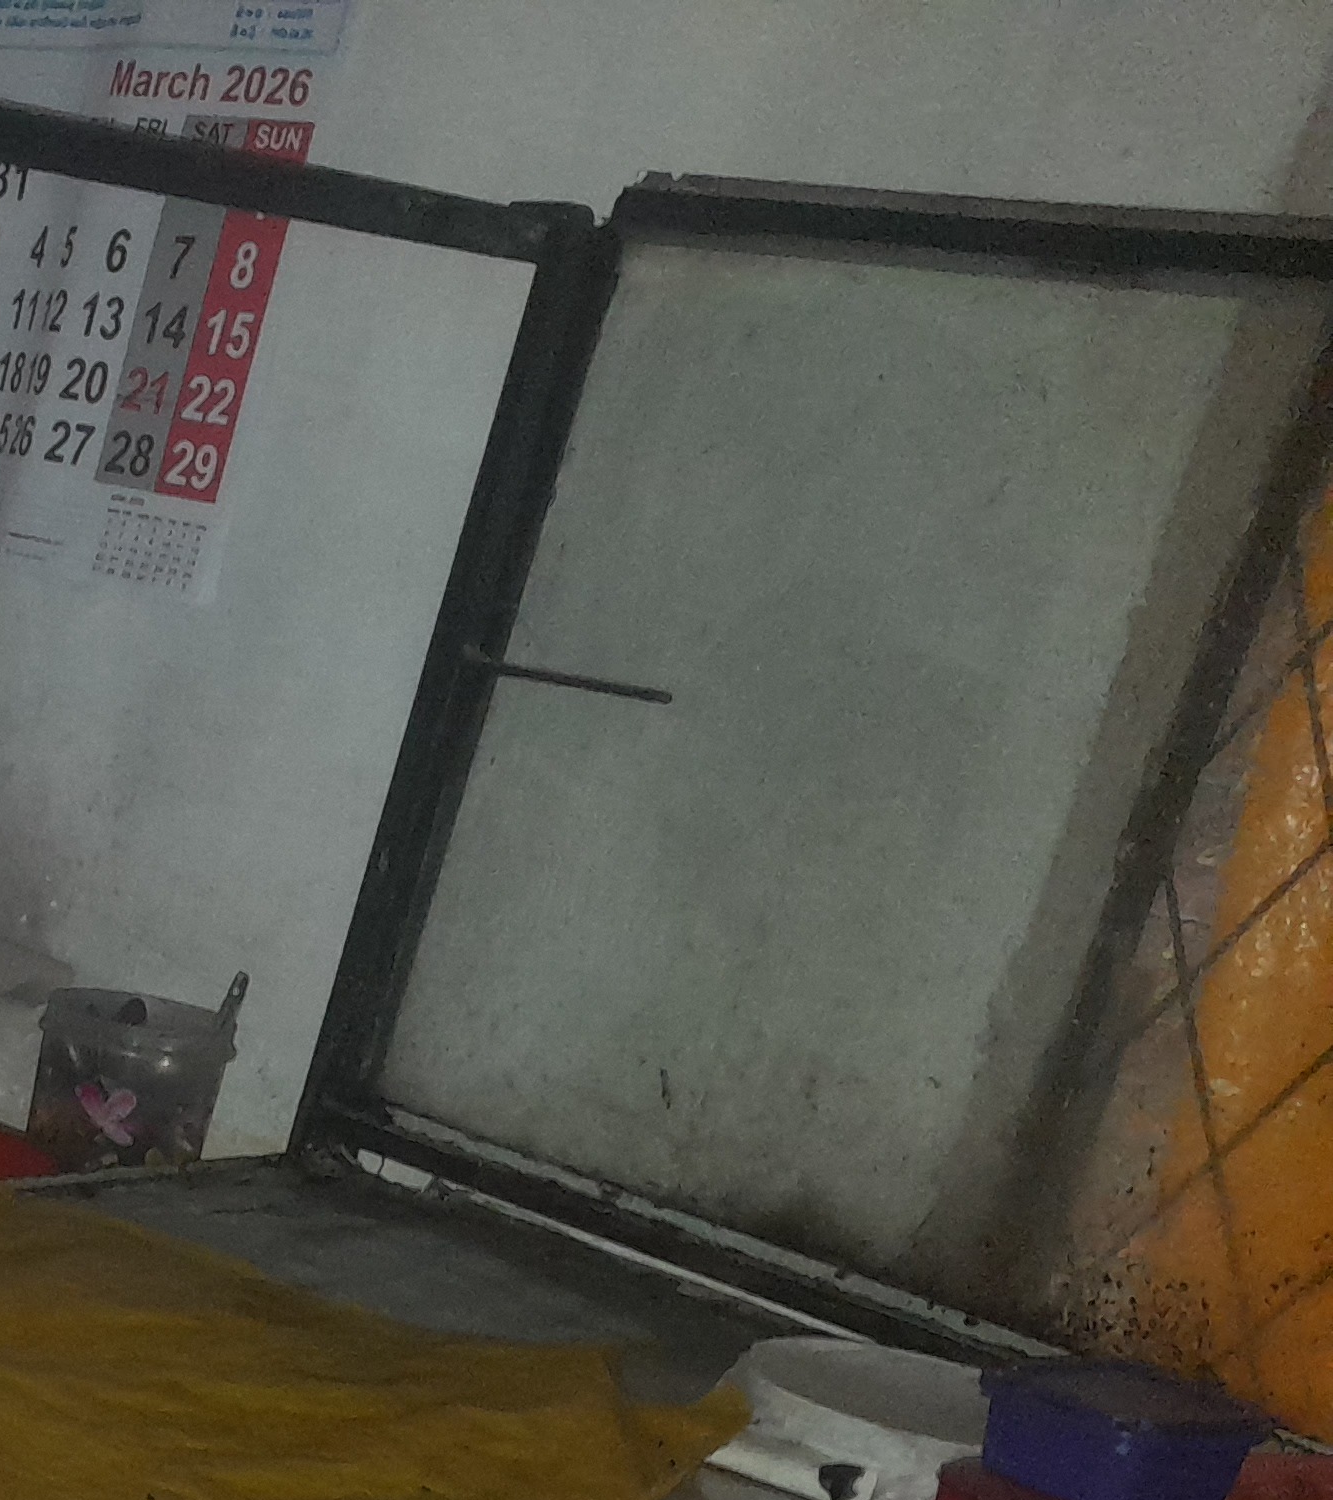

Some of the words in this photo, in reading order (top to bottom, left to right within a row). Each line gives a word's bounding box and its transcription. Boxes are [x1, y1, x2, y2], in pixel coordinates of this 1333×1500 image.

[110, 59, 210, 101] March
[220, 64, 314, 107] 2026
[195, 121, 235, 144] SAT
[254, 123, 303, 151] SUN
[31, 225, 48, 268] 4
[60, 226, 78, 268] 5
[106, 228, 132, 273] 6
[169, 235, 196, 279] 7
[230, 241, 257, 290] 8
[83, 294, 125, 341] 13
[145, 302, 188, 348] 14
[205, 309, 254, 358] 15
[0, 351, 26, 394] 18
[27, 353, 52, 395] 19
[59, 358, 108, 405] 20
[121, 369, 169, 415] 21
[180, 377, 233, 425] 22
[44, 424, 96, 467] 27
[105, 431, 154, 476] 28
[163, 440, 218, 489] 29
